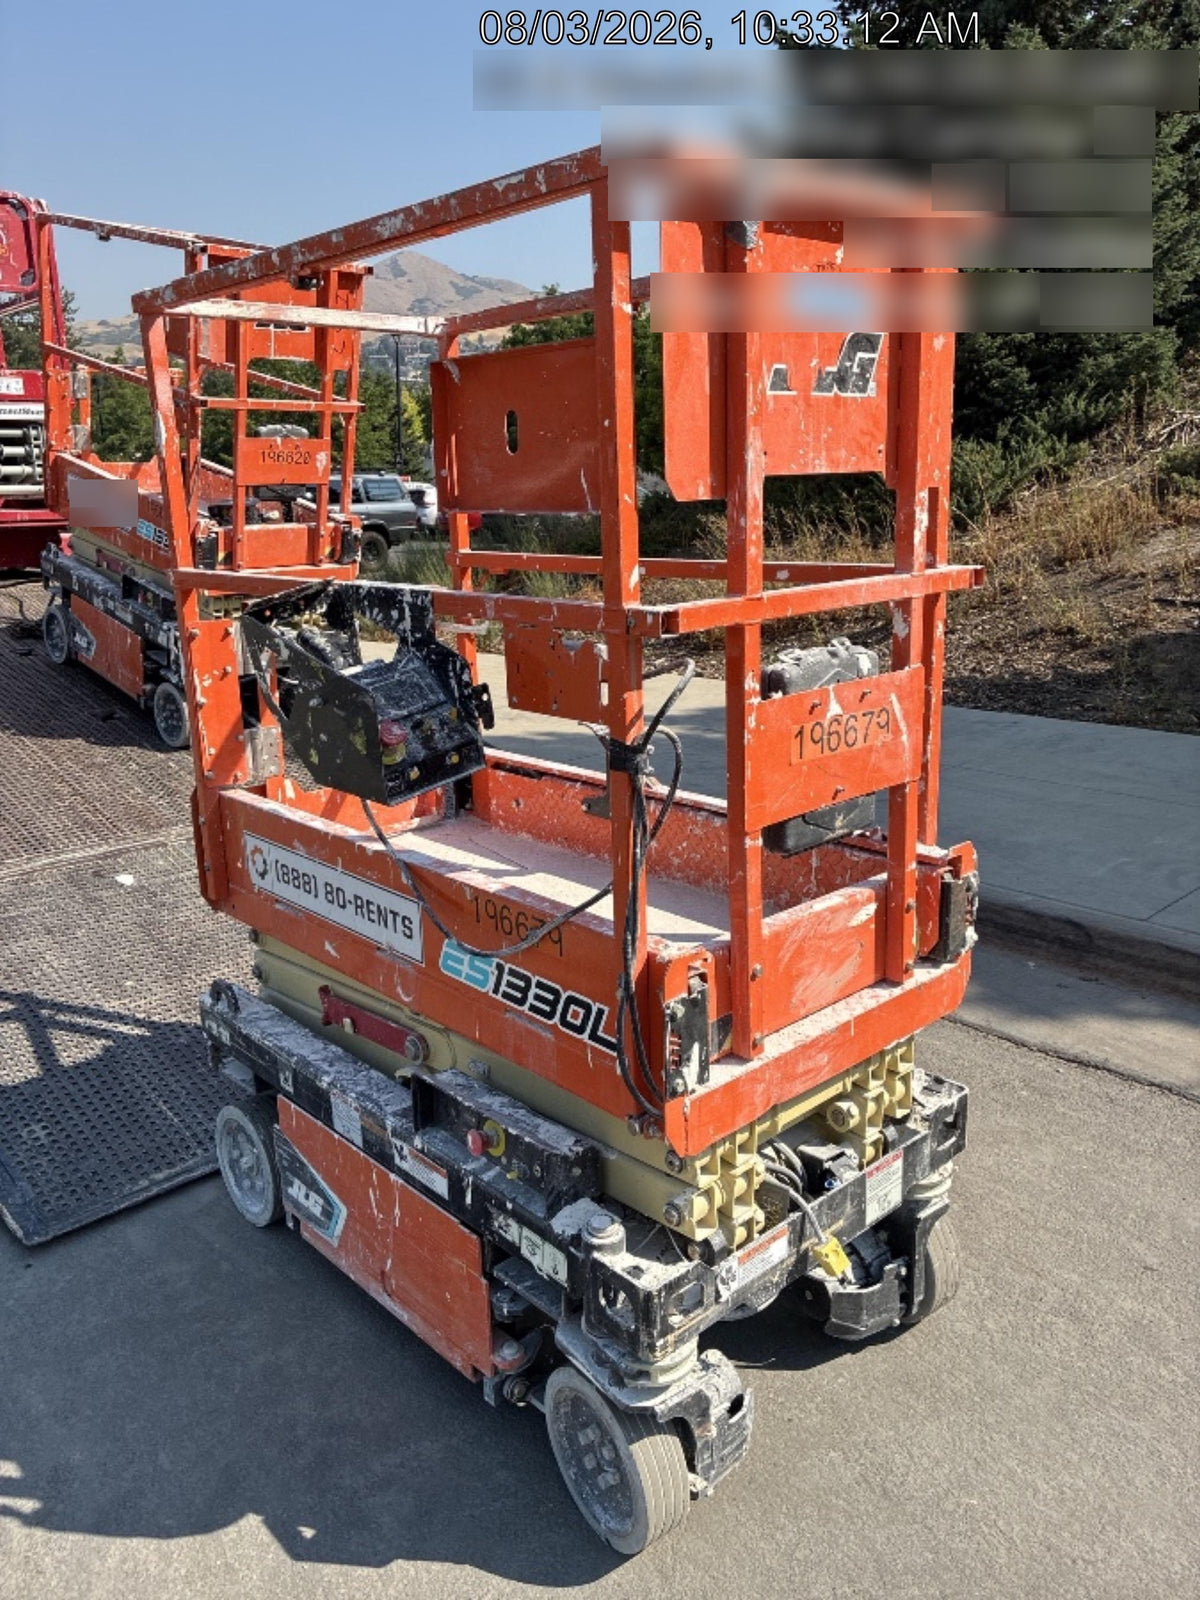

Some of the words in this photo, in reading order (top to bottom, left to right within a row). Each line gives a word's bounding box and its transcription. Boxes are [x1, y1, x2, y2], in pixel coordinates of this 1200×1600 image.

[260, 449, 312, 465] 196620
[794, 706, 890, 760] 196679
[274, 857, 319, 901] (888)
[324, 879, 414, 941] 80-RENTS
[439, 938, 618, 1055] ES1330L
[286, 1176, 325, 1219] JLG
